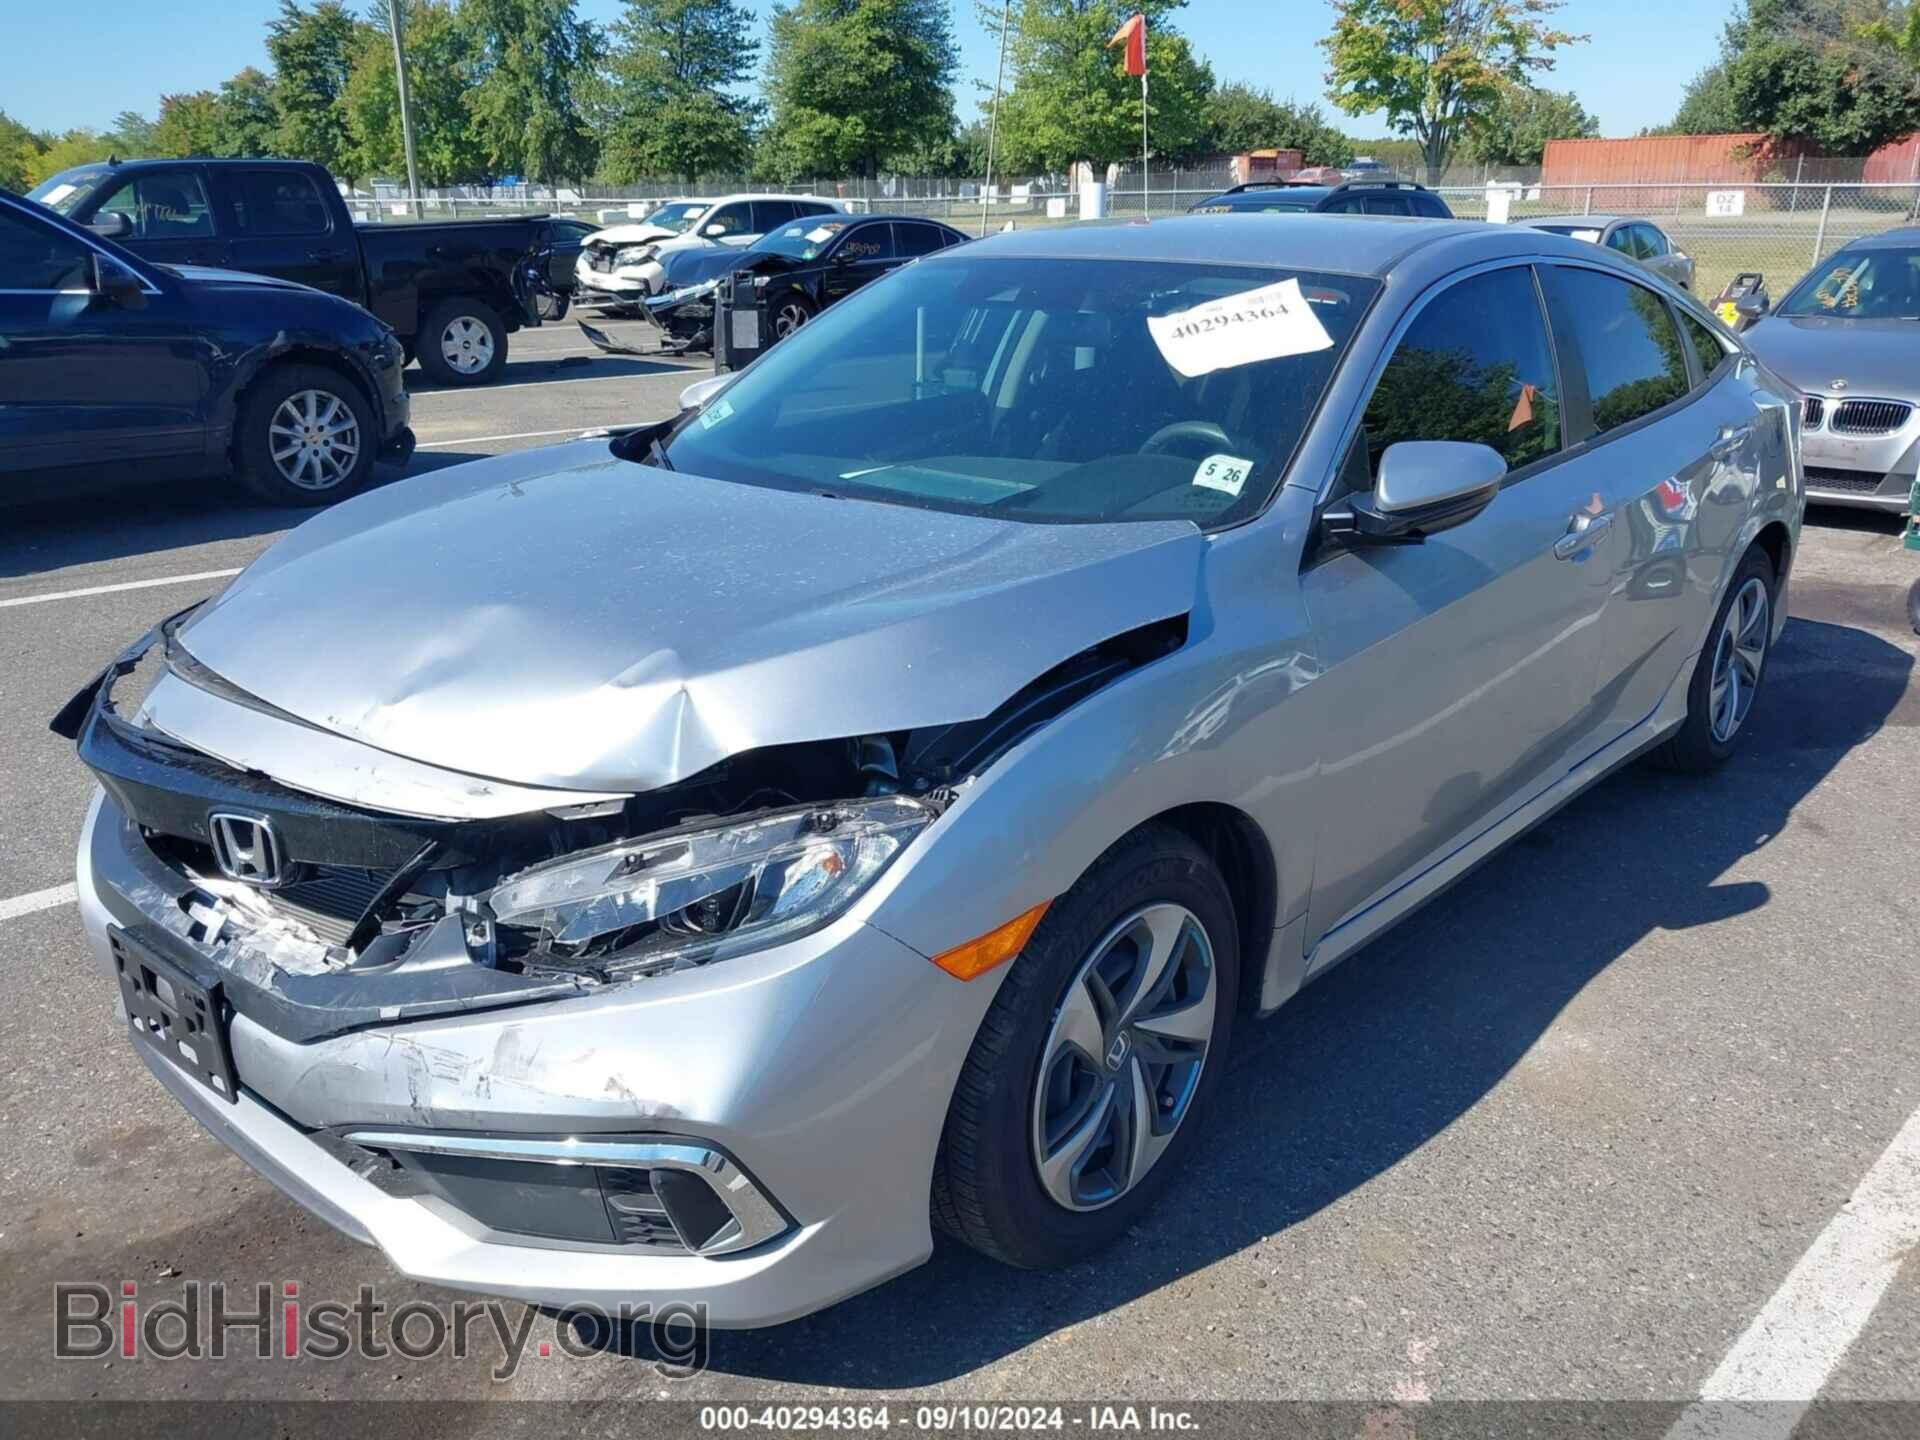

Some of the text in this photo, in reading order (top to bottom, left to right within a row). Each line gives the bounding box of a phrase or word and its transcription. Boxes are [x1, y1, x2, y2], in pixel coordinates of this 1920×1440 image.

[1171, 303, 1289, 339] 40294364
[1205, 463, 1242, 482] 5 26
